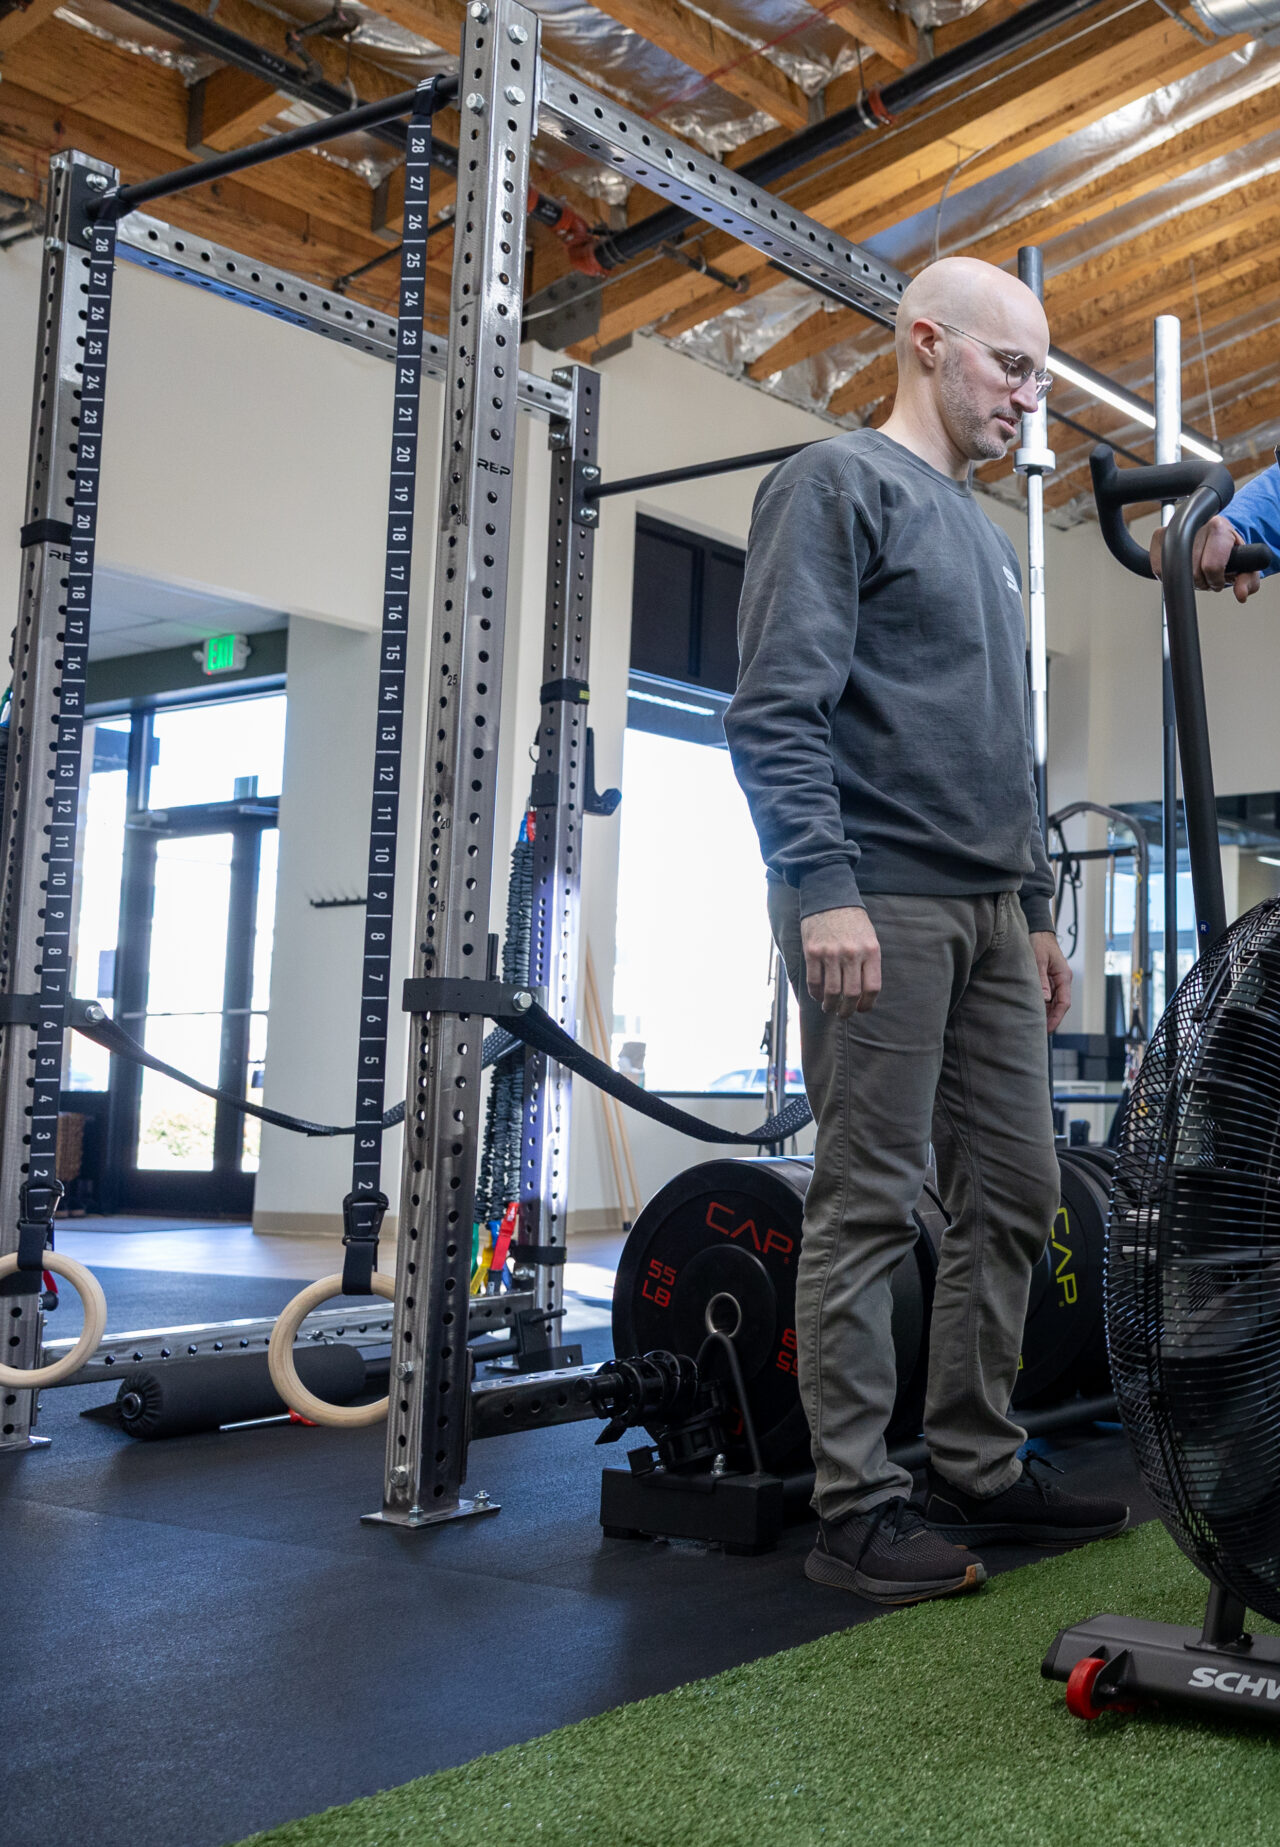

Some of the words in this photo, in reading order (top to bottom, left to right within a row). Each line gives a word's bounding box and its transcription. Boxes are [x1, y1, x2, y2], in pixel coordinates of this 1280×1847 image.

[412, 138, 425, 153] 28
[410, 176, 423, 191] 27
[409, 215, 422, 229] 26
[96, 238, 109, 252] 28
[407, 253, 420, 267] 25
[94, 272, 106, 286] 27
[405, 292, 418, 306] 24
[91, 307, 104, 320] 26
[403, 330, 416, 345] 23
[89, 341, 102, 354] 25
[465, 354, 476, 367] 35
[87, 375, 100, 389] 24
[401, 369, 414, 383] 22
[84, 410, 97, 424] 23
[399, 408, 412, 421] 21
[82, 445, 95, 458] 22
[397, 447, 410, 462] 20
[477, 458, 511, 476] REP
[80, 480, 93, 492] 21
[395, 487, 408, 501] 19
[77, 515, 90, 528] 20
[393, 526, 406, 540] 18
[49, 549, 71, 563] RE
[75, 551, 88, 564] 19
[391, 566, 404, 580] 17
[72, 586, 85, 599] 18
[388, 606, 402, 620] 16
[70, 621, 83, 634] 17
[208, 634, 236, 670] EXIT
[386, 645, 400, 659] 15
[67, 656, 81, 669] 16
[447, 674, 458, 686] 25
[65, 692, 78, 705] 15
[384, 686, 398, 700] 14
[63, 728, 76, 741] 14
[382, 726, 396, 740] 13
[60, 764, 73, 776] 13
[380, 766, 393, 780] 12
[58, 800, 71, 813] 12
[377, 807, 391, 819] 11
[56, 836, 69, 847] 11
[375, 848, 389, 862] 10
[53, 872, 66, 885] 10
[435, 901, 446, 912] 15
[363, 1098, 377, 1106] 4
[706, 1202, 793, 1254] CAP
[648, 1259, 677, 1287] 55
[642, 1280, 672, 1308] LB
